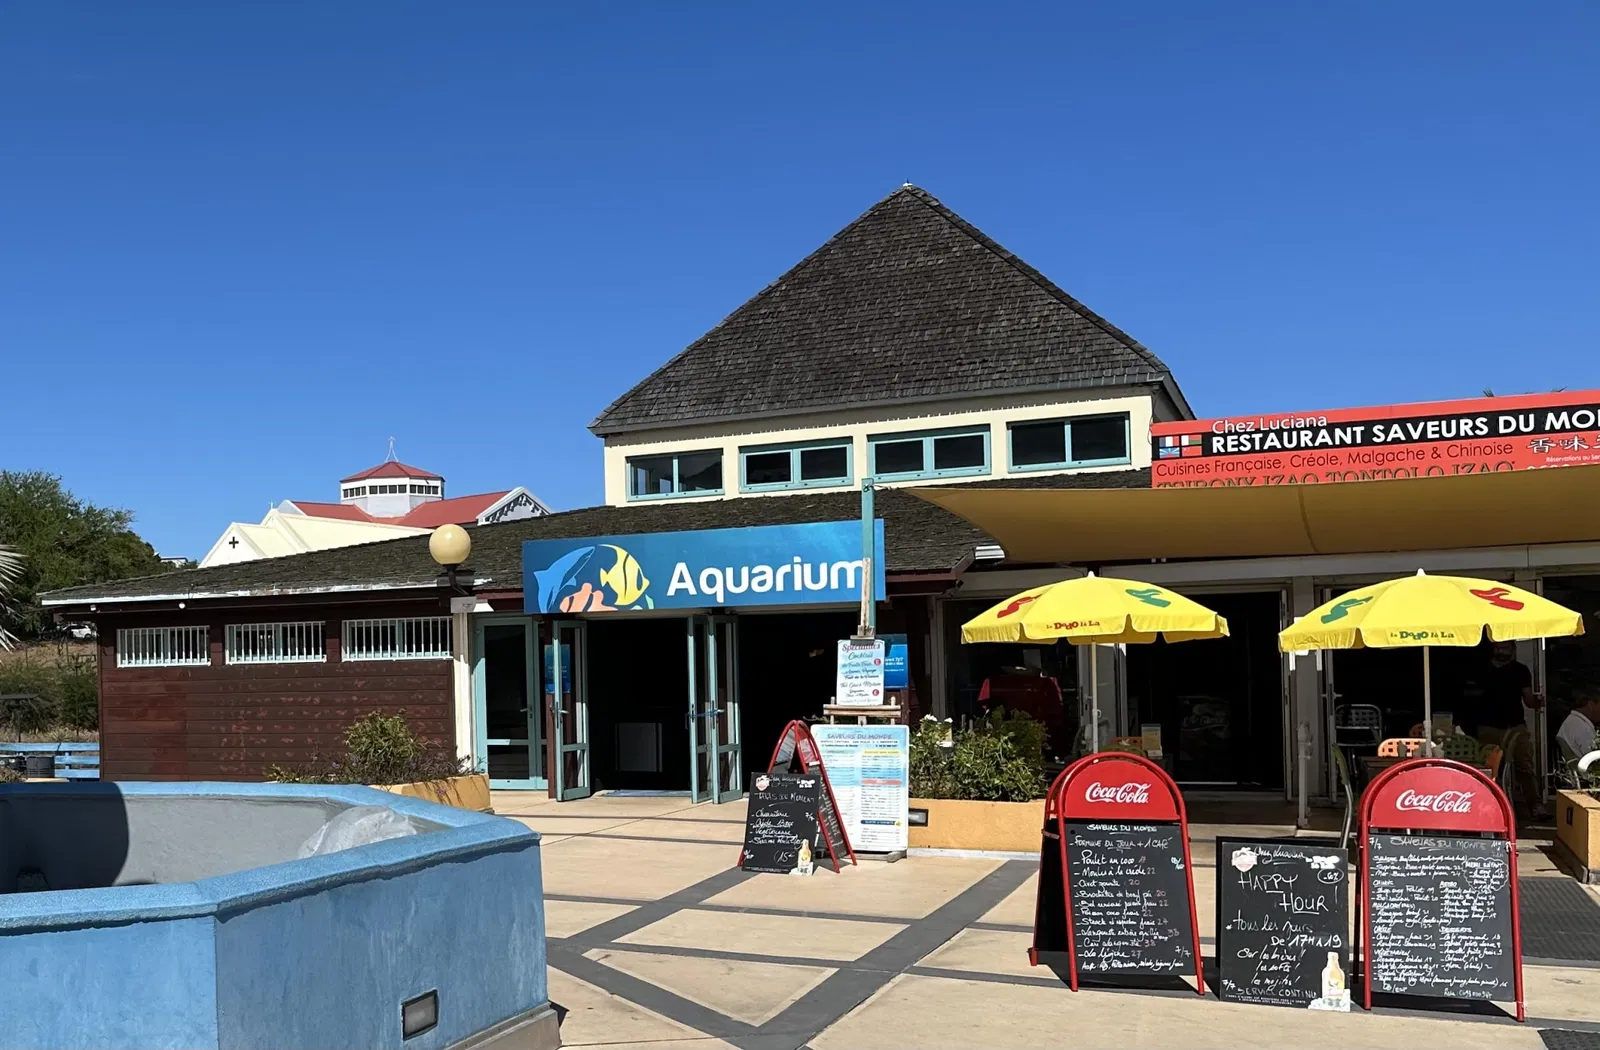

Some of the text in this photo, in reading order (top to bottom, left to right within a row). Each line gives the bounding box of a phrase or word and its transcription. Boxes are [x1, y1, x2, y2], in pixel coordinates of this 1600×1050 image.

[1212, 414, 1327, 434] Chez Luciana
[1212, 426, 1365, 454] RESTAURANT
[1372, 417, 1489, 443] SAVEURS
[1499, 413, 1535, 434] DU
[1527, 434, 1600, 454] 香味
[1156, 441, 1514, 477] Cuisines Française, Créole, Malgache & Chinoise
[666, 556, 864, 603] Aquarium
[1085, 782, 1152, 804] Coca-Cola
[1395, 789, 1476, 814] Coca-Cola
[1087, 824, 1158, 833] SAVEURS DU MONDE
[1116, 840, 1136, 848] JOUR
[1238, 871, 1299, 892] HAPPY
[1279, 892, 1329, 913] HOUR
[1261, 914, 1279, 931] les
[1175, 945, 1191, 958] 7/7
[1236, 988, 1317, 999] SERVICE CONTINU
